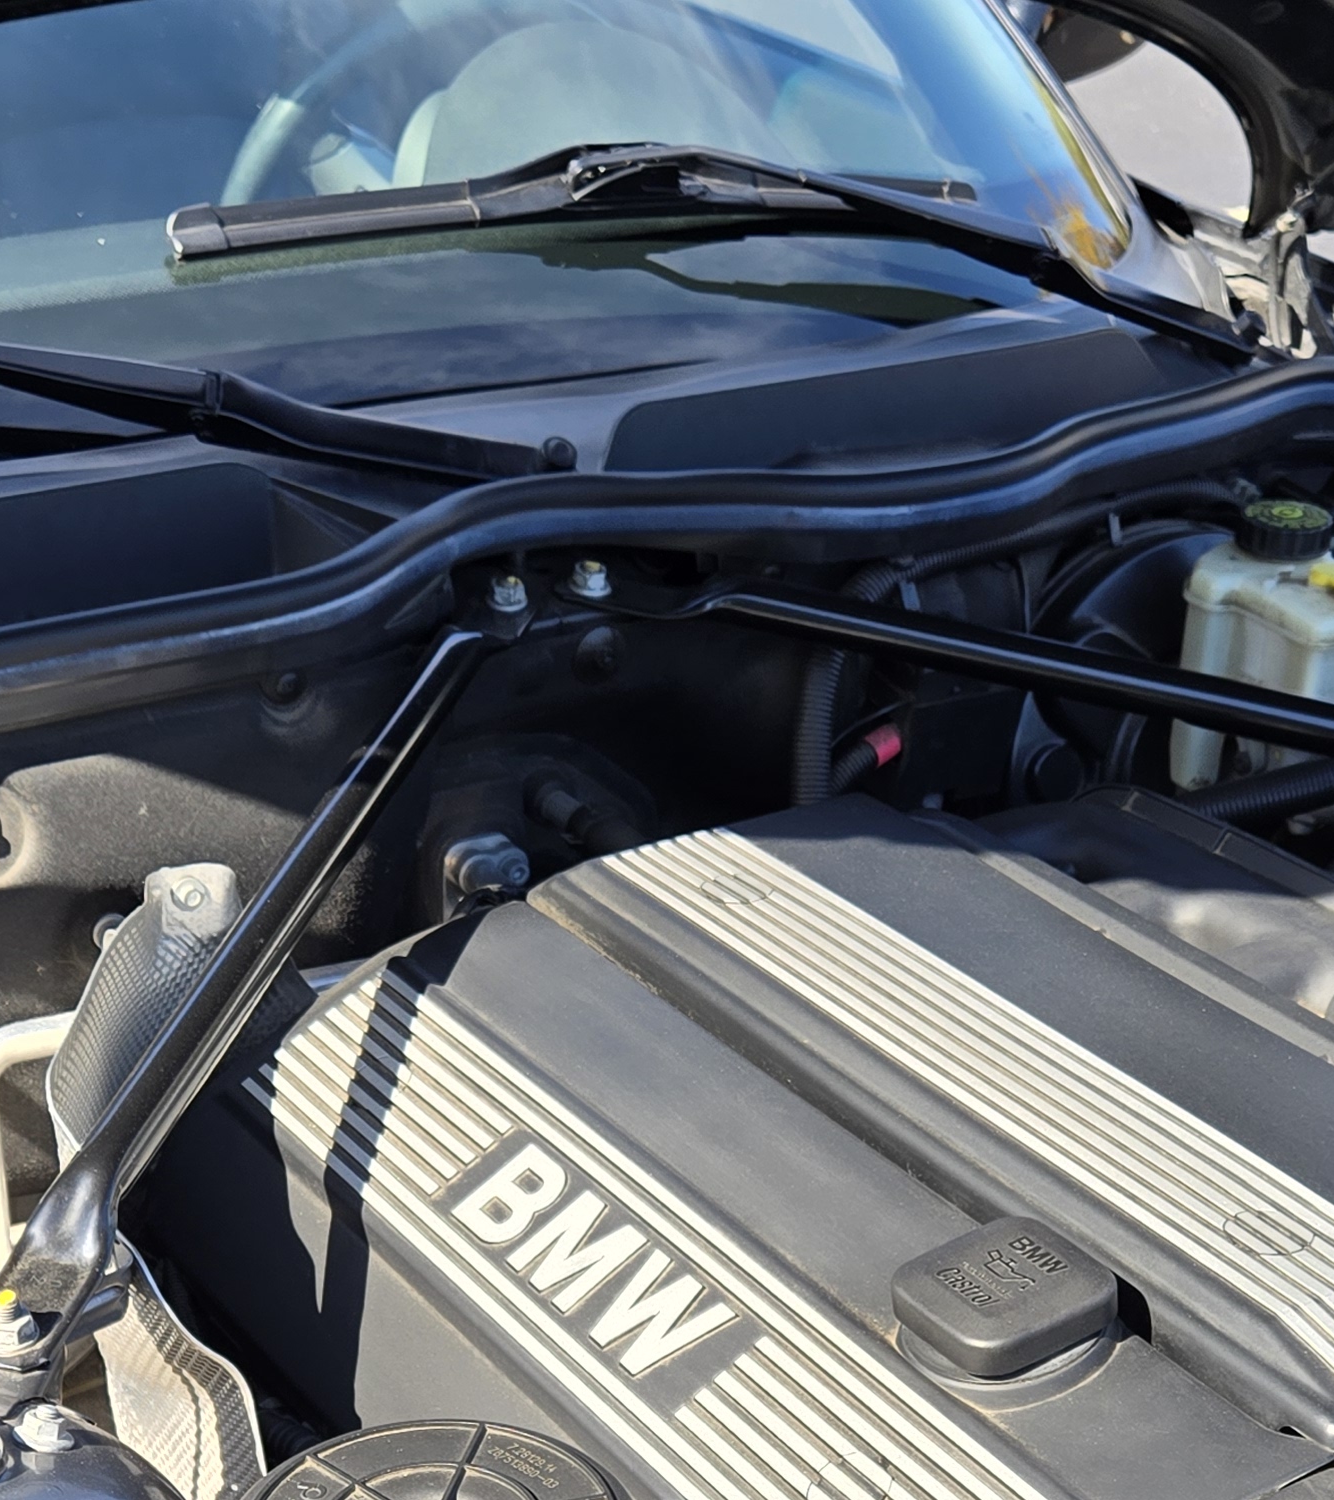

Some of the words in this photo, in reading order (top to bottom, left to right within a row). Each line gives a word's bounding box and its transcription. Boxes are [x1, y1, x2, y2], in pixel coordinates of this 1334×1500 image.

[450, 1143, 739, 1377] BMW
[1008, 1236, 1068, 1273] BMW
[935, 1267, 1000, 1307] Castrol
